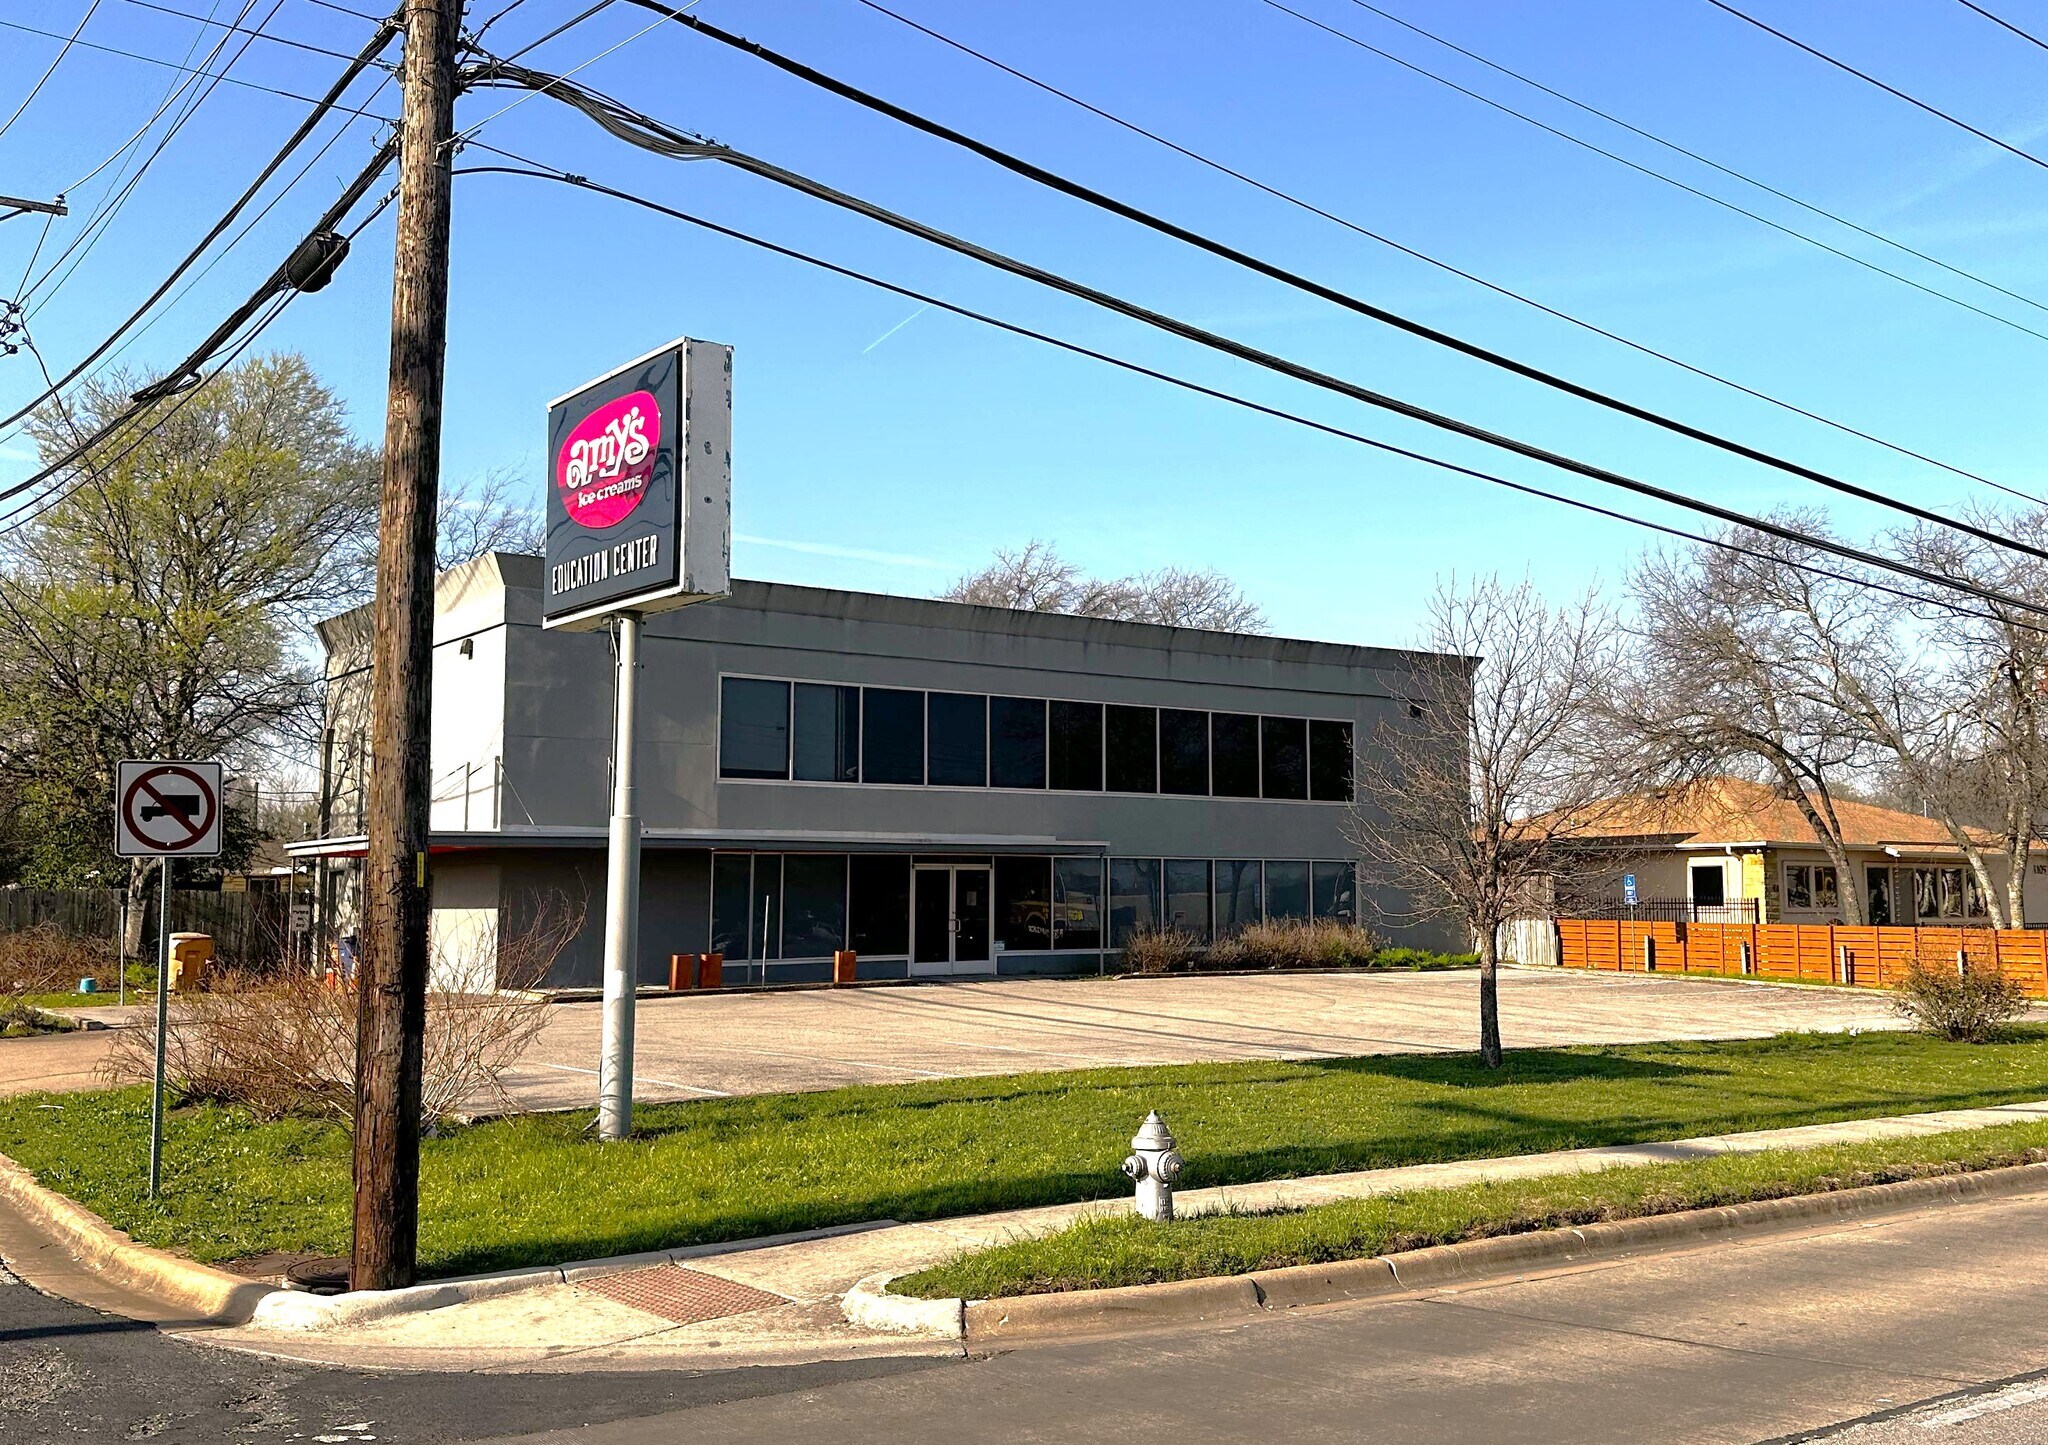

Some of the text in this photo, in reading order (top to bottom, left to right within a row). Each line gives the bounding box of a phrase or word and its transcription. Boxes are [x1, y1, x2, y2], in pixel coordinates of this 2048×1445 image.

[578, 474, 642, 508] ice creams
[552, 534, 658, 596] EDUCATION CENTER
